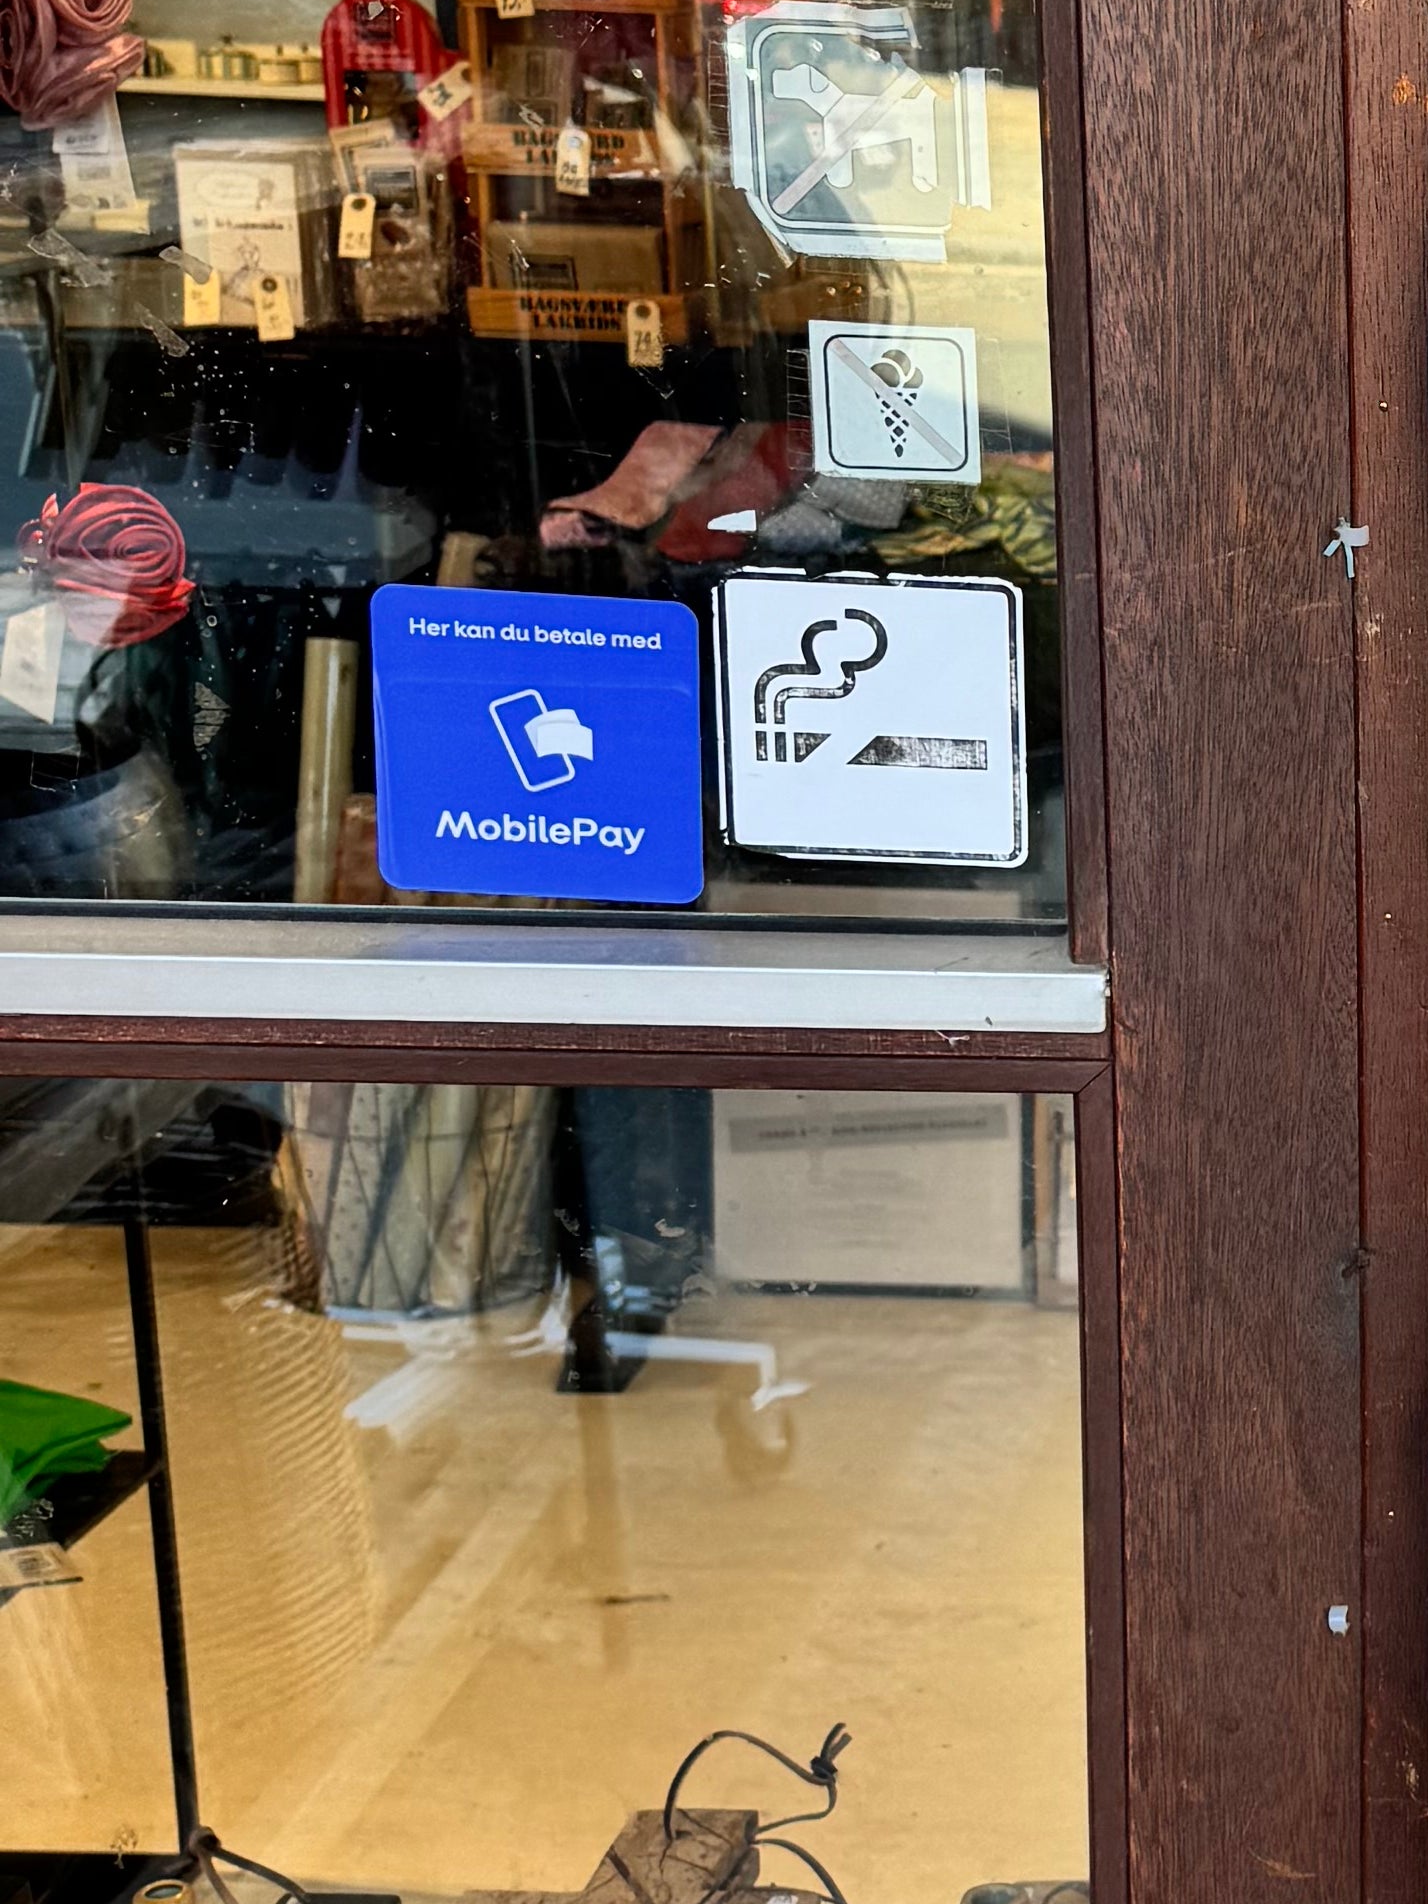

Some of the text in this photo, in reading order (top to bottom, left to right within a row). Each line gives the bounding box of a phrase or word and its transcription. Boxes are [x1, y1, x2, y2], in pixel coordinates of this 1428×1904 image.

[408, 617, 662, 651] Her kan du betale med
[435, 809, 646, 856] MobilePay
